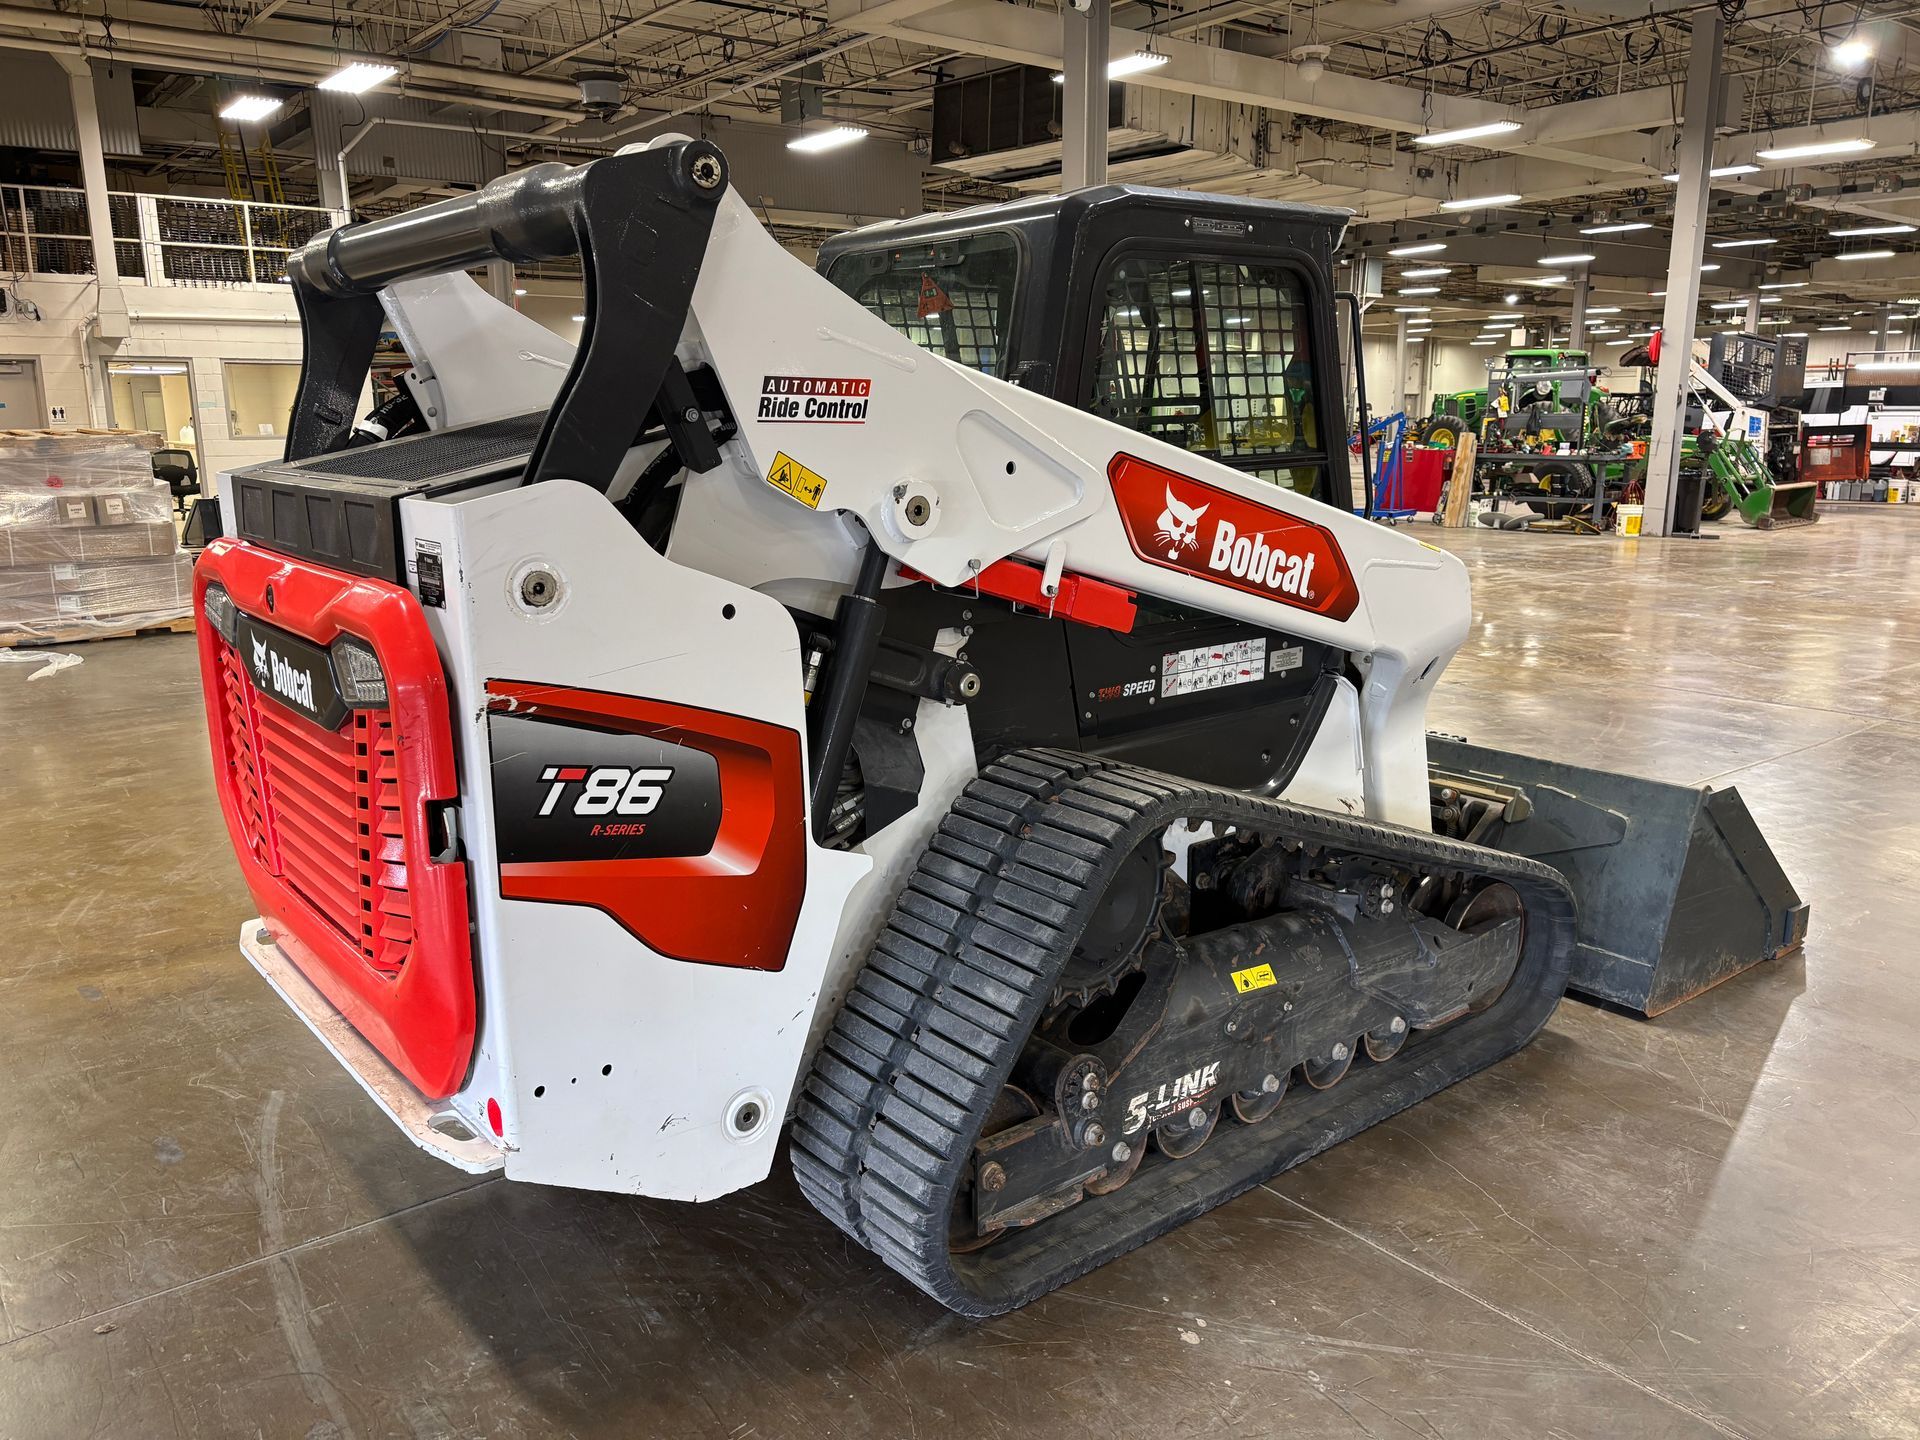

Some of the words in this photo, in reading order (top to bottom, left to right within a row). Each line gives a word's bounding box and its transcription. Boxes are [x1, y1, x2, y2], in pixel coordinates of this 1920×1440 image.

[766, 379, 868, 395] AUTOMATIC
[757, 396, 800, 418] Ride
[804, 397, 869, 419] Control
[1208, 519, 1315, 598] Bobcat
[269, 649, 315, 712] Bobcat
[1122, 679, 1156, 697] SPEED
[538, 767, 673, 816] T86
[590, 823, 647, 836] R-SERIES
[1122, 1060, 1221, 1136] 5-LINK
